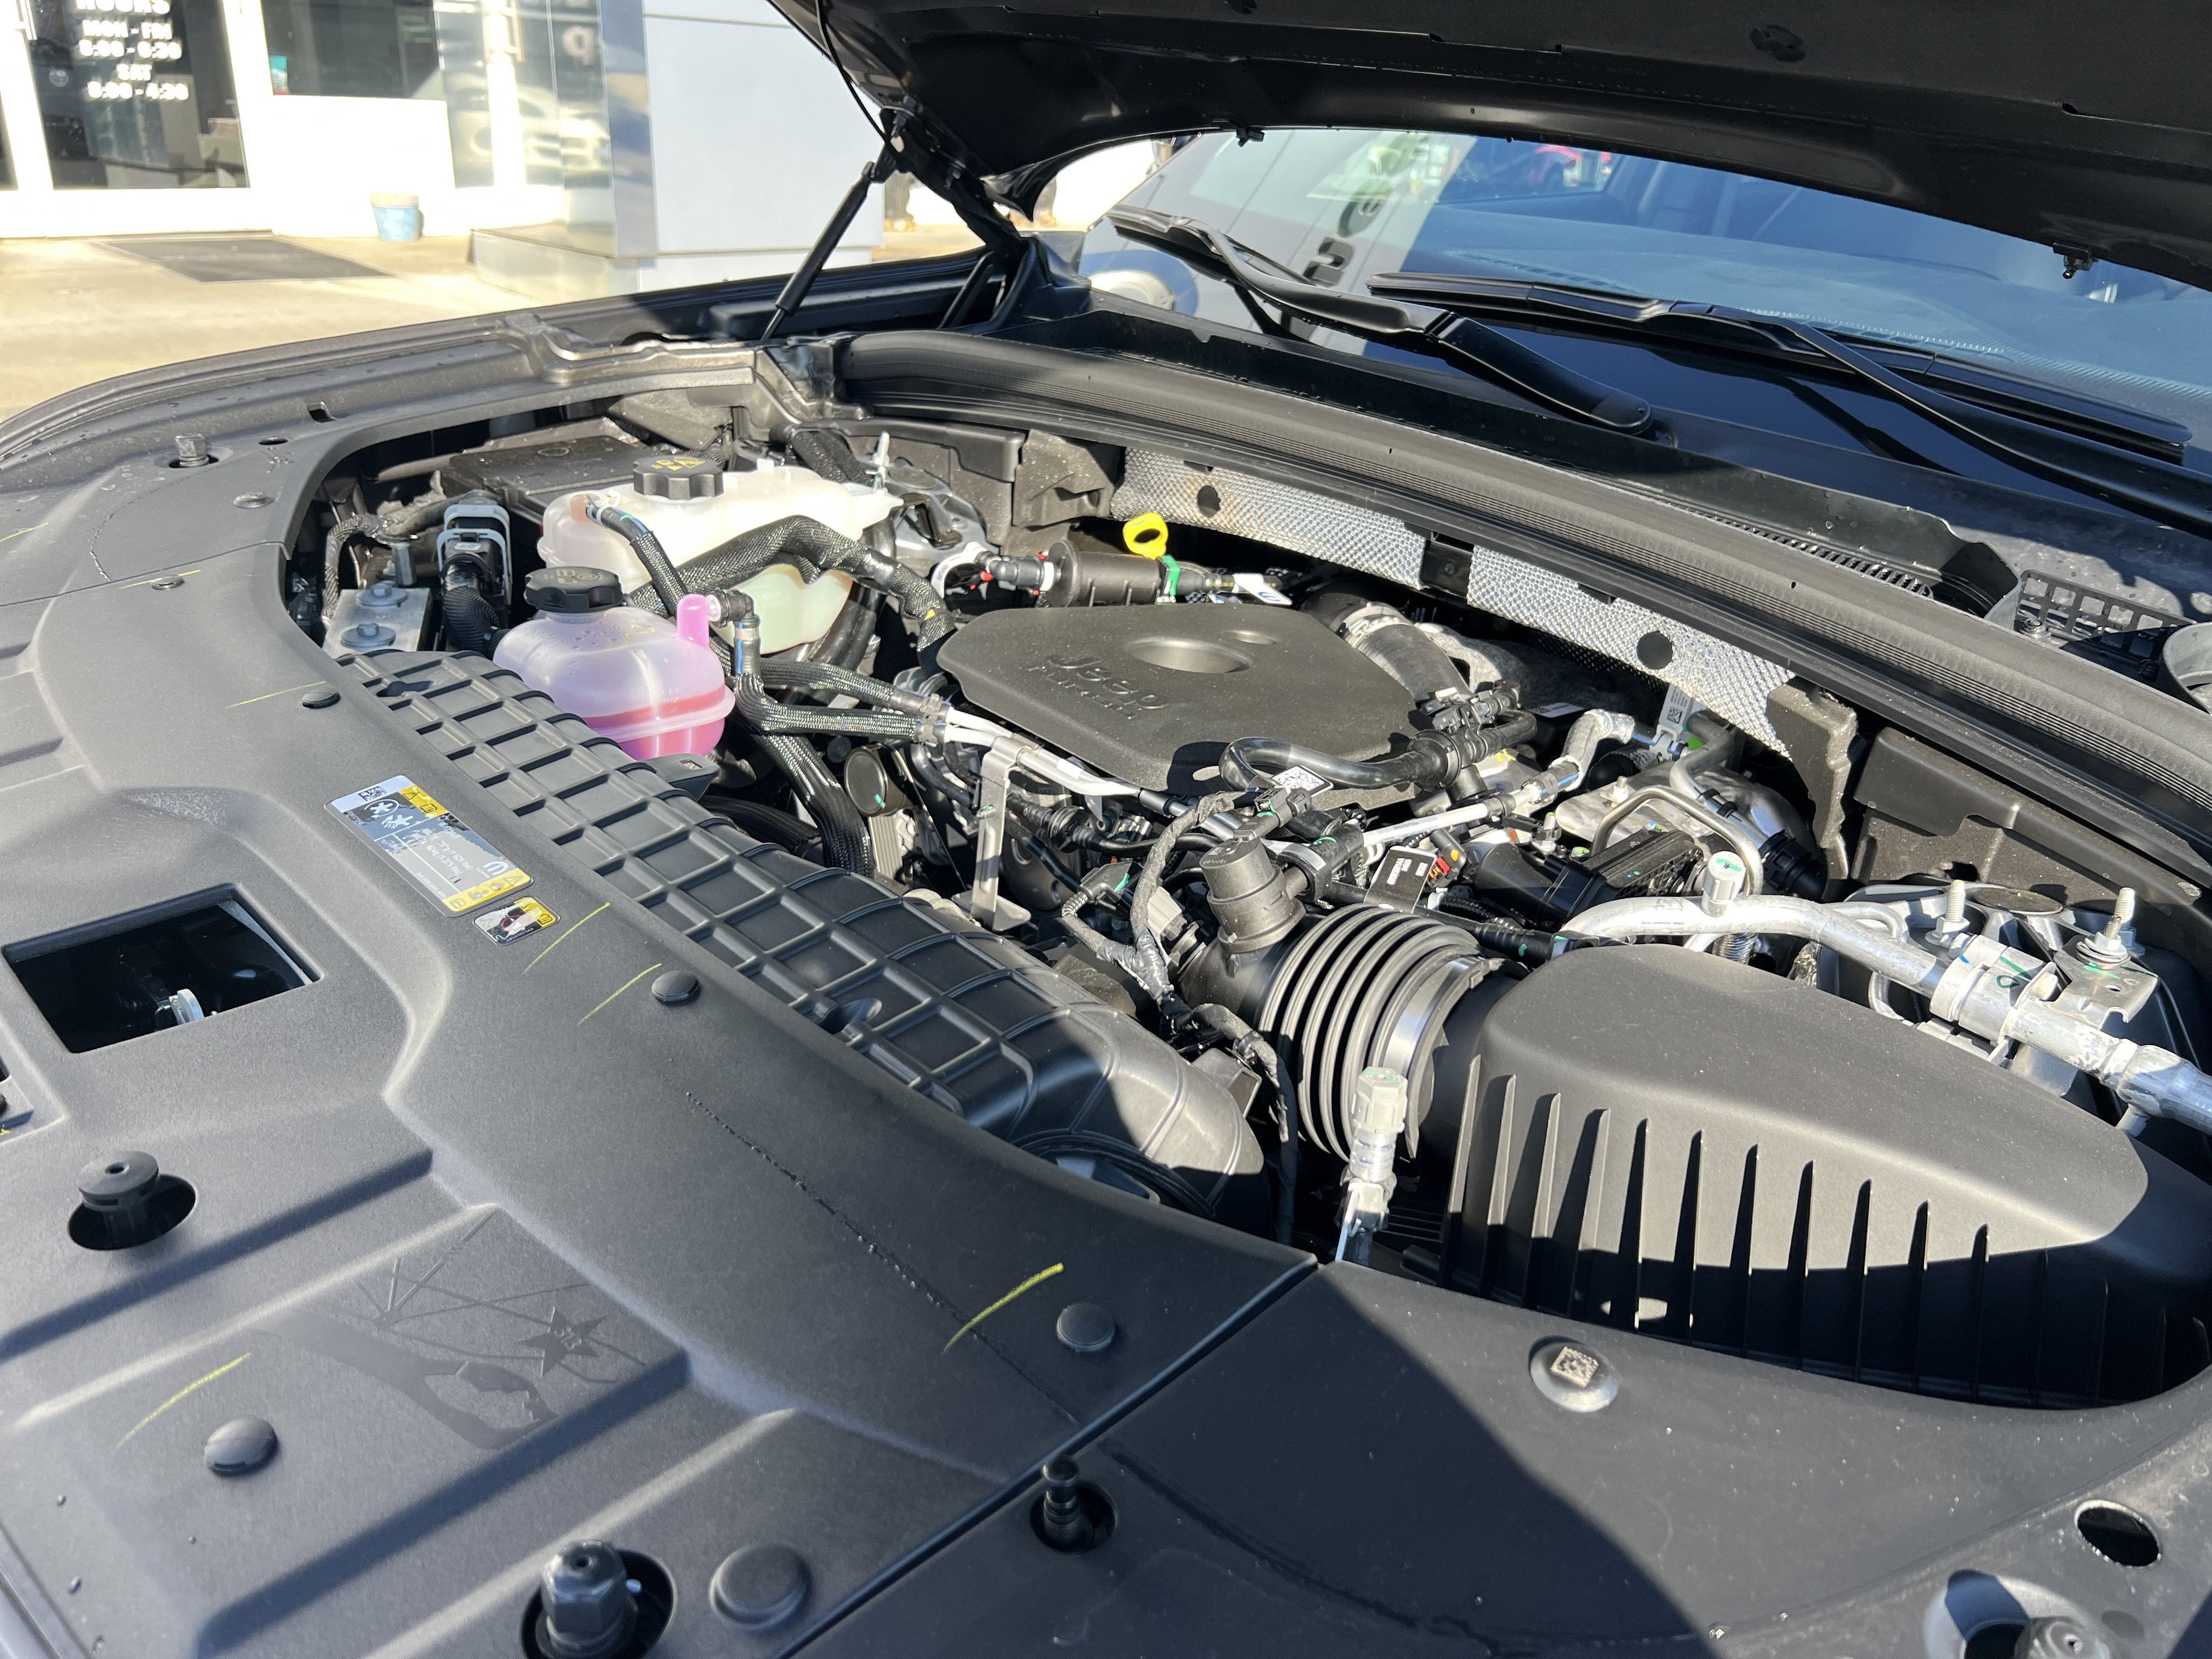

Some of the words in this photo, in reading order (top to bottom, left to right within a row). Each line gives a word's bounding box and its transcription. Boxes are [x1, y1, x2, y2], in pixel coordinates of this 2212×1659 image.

[82, 20, 128, 37] MON
[116, 64, 152, 80] SAT
[1046, 653, 1170, 709] Jeep
